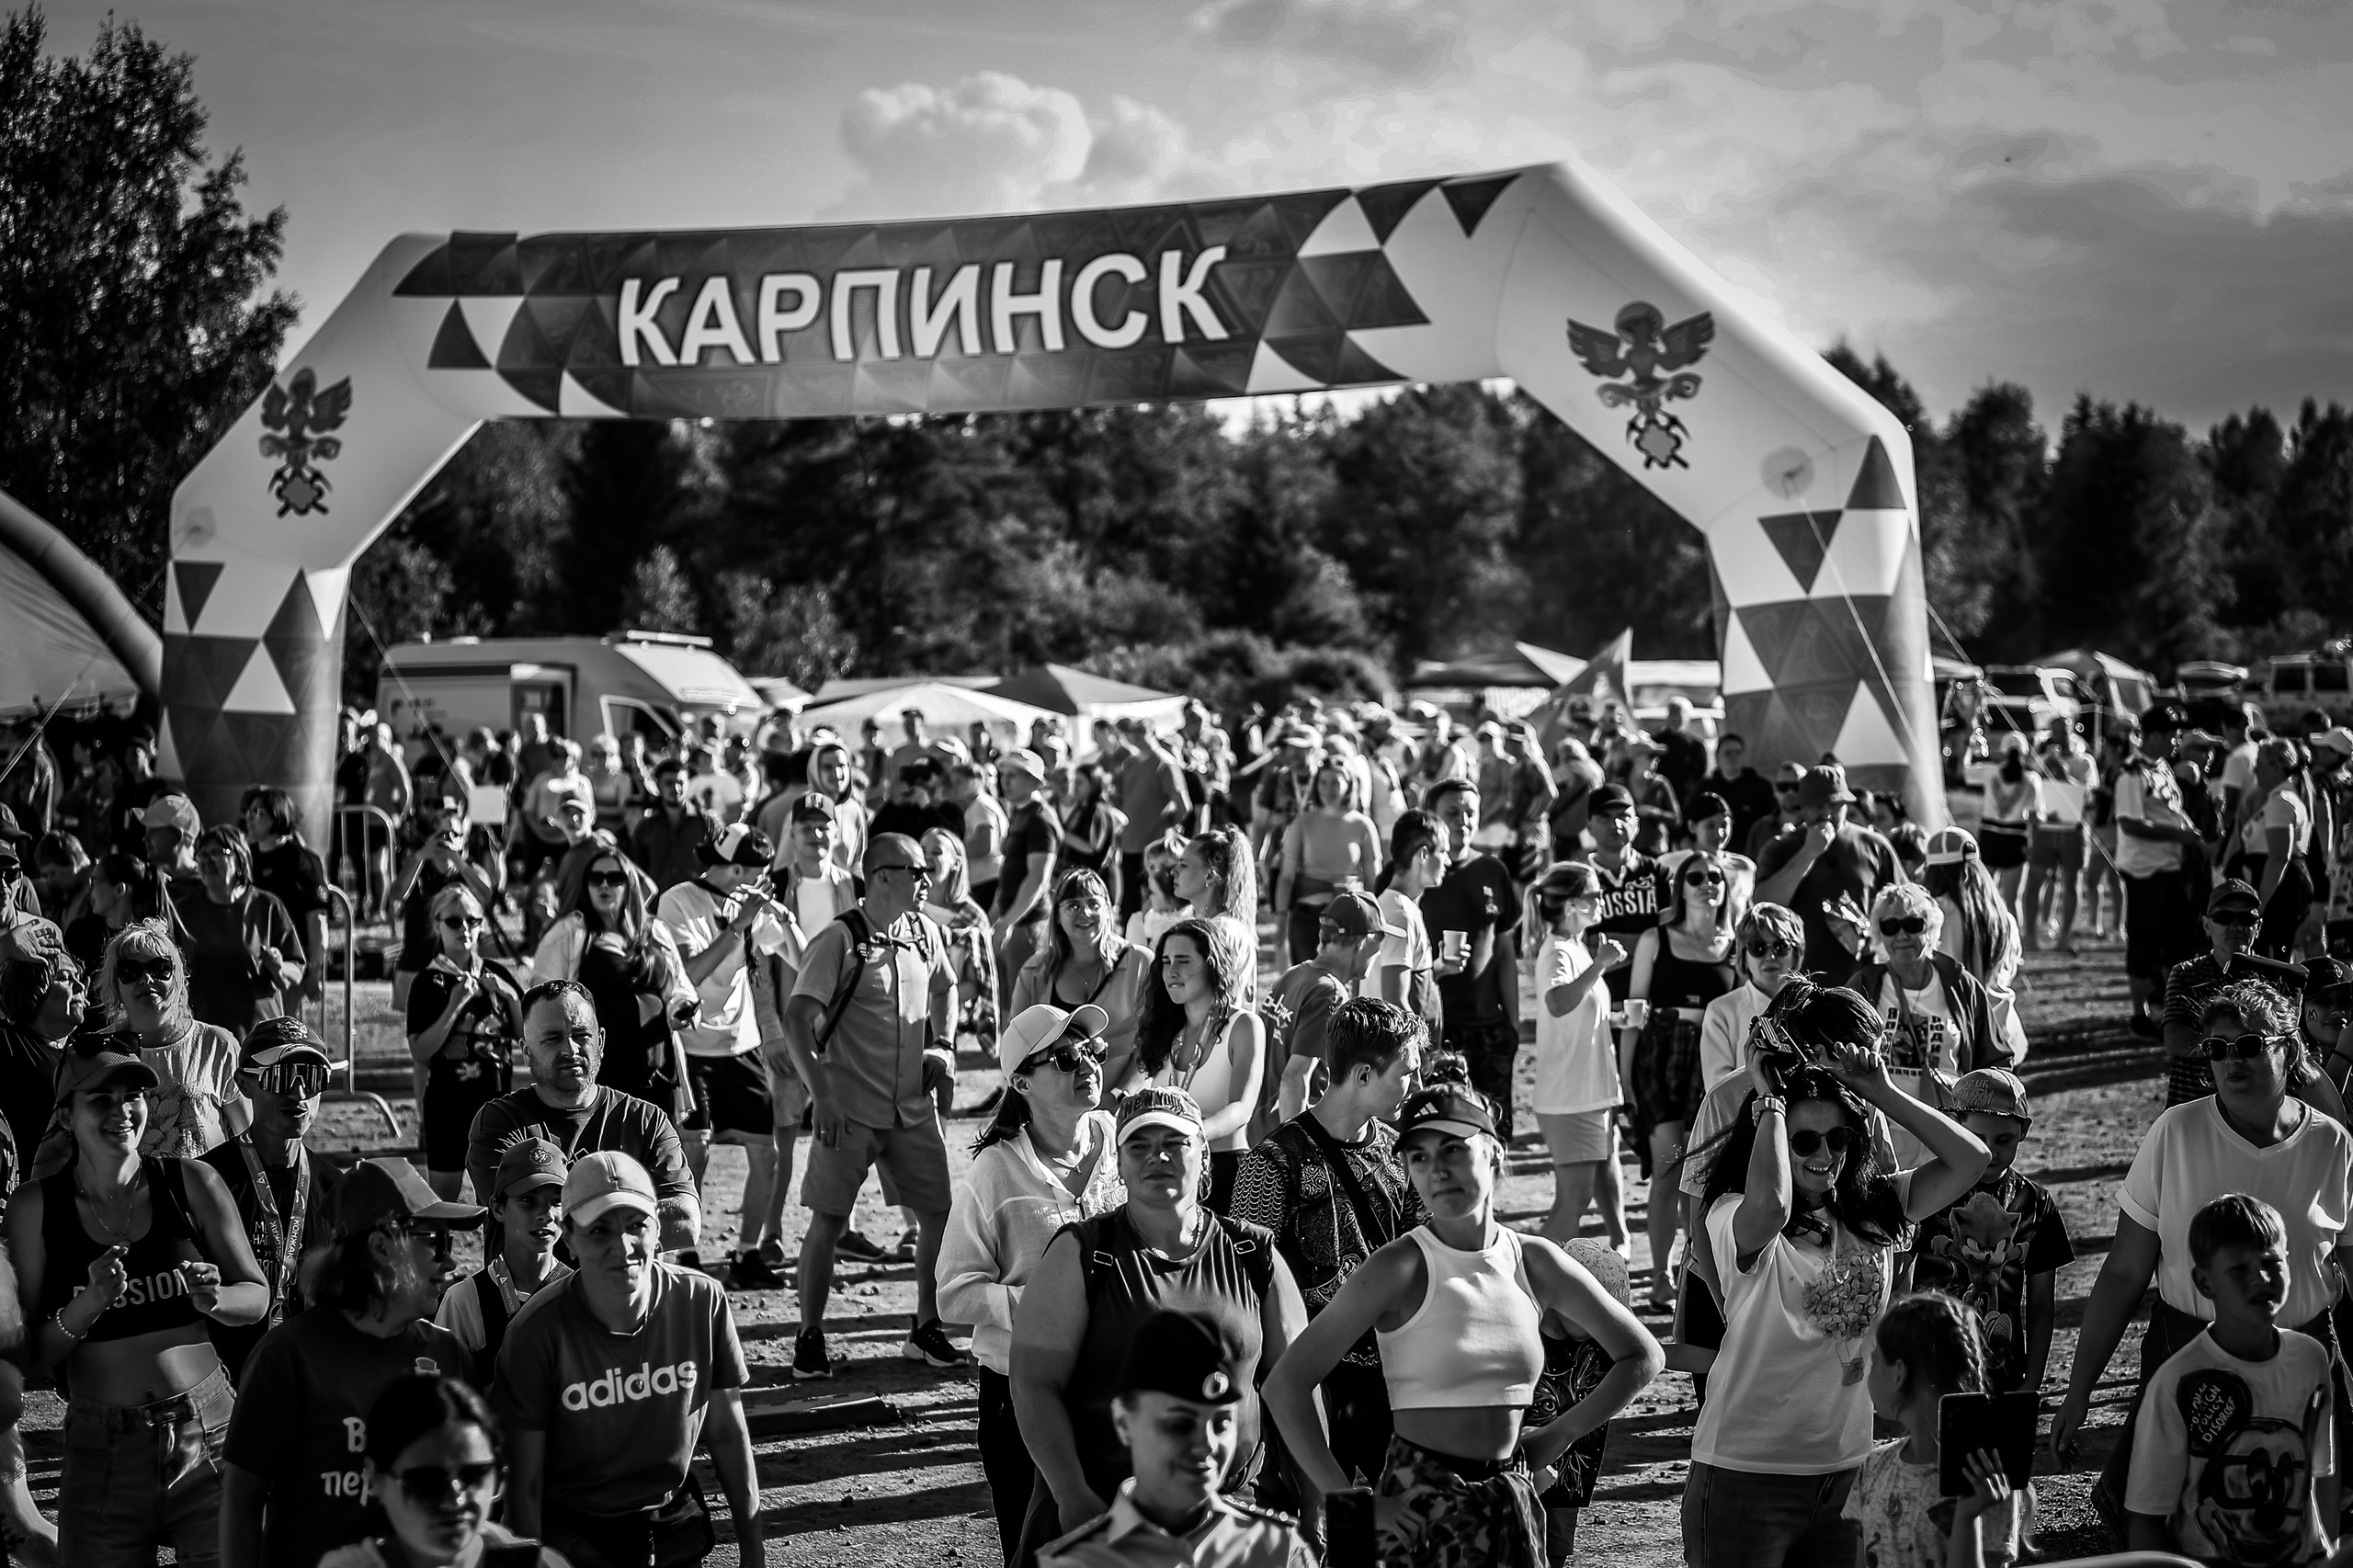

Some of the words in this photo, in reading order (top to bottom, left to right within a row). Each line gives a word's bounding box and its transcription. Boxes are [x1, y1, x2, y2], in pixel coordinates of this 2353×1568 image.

[617, 244, 1230, 367] КАРПИНСК
[1602, 887, 1658, 919] USSIA
[287, 1218, 301, 1260] КОНЖАК
[561, 1360, 698, 1412] adidas
